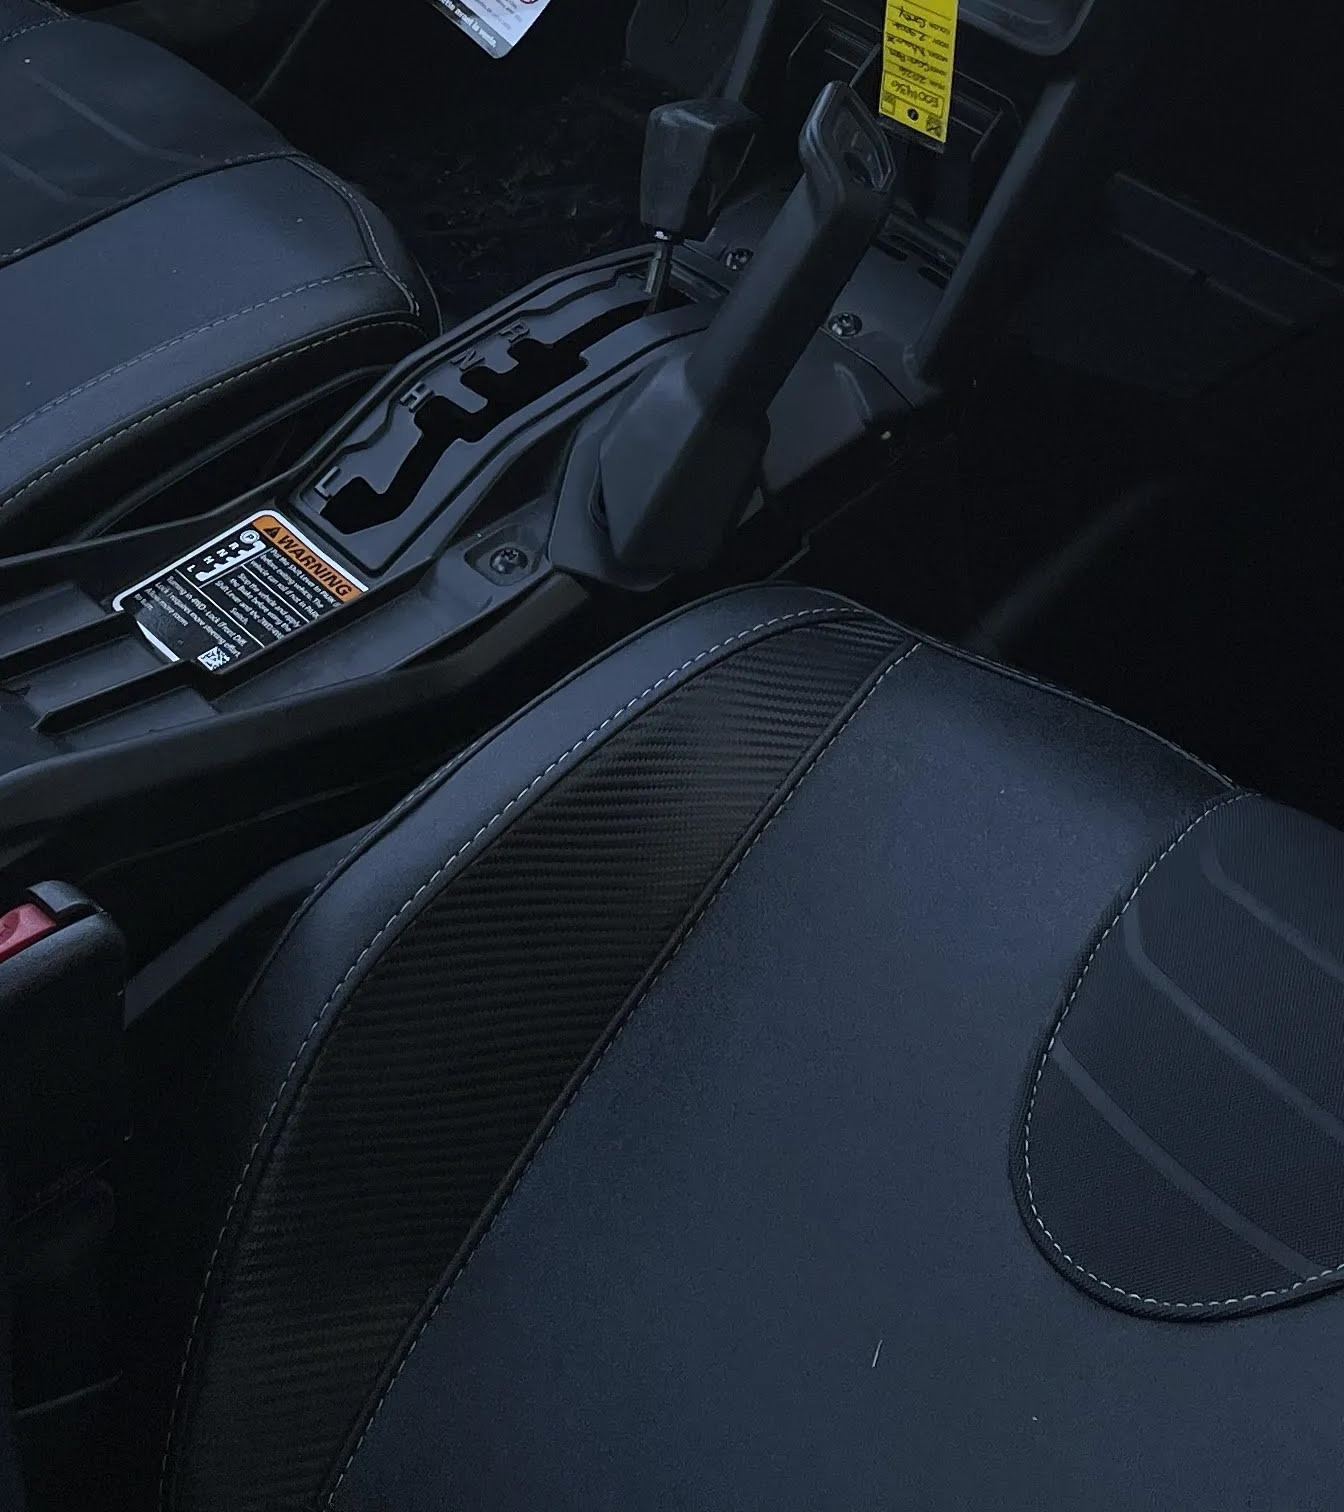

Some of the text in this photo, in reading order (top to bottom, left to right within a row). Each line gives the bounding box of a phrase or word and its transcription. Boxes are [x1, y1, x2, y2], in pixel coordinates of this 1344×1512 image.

[498, 320, 530, 344] R
[451, 350, 485, 372] N
[399, 381, 435, 412] H
[315, 466, 342, 500] L
[202, 555, 215, 564] H
[215, 547, 229, 557] N
[227, 541, 240, 550] R
[185, 564, 198, 573] L
[259, 553, 280, 570] before
[310, 597, 326, 608] The
[275, 534, 354, 597] WARNING
[277, 556, 291, 566] the
[286, 563, 303, 576] Shift
[298, 573, 317, 588] Lever
[163, 575, 189, 596] Turning
[189, 596, 207, 610] 4WD
[204, 610, 222, 623] Lock
[214, 579, 230, 592] Shift
[225, 589, 243, 603] Lever
[238, 601, 253, 612] and
